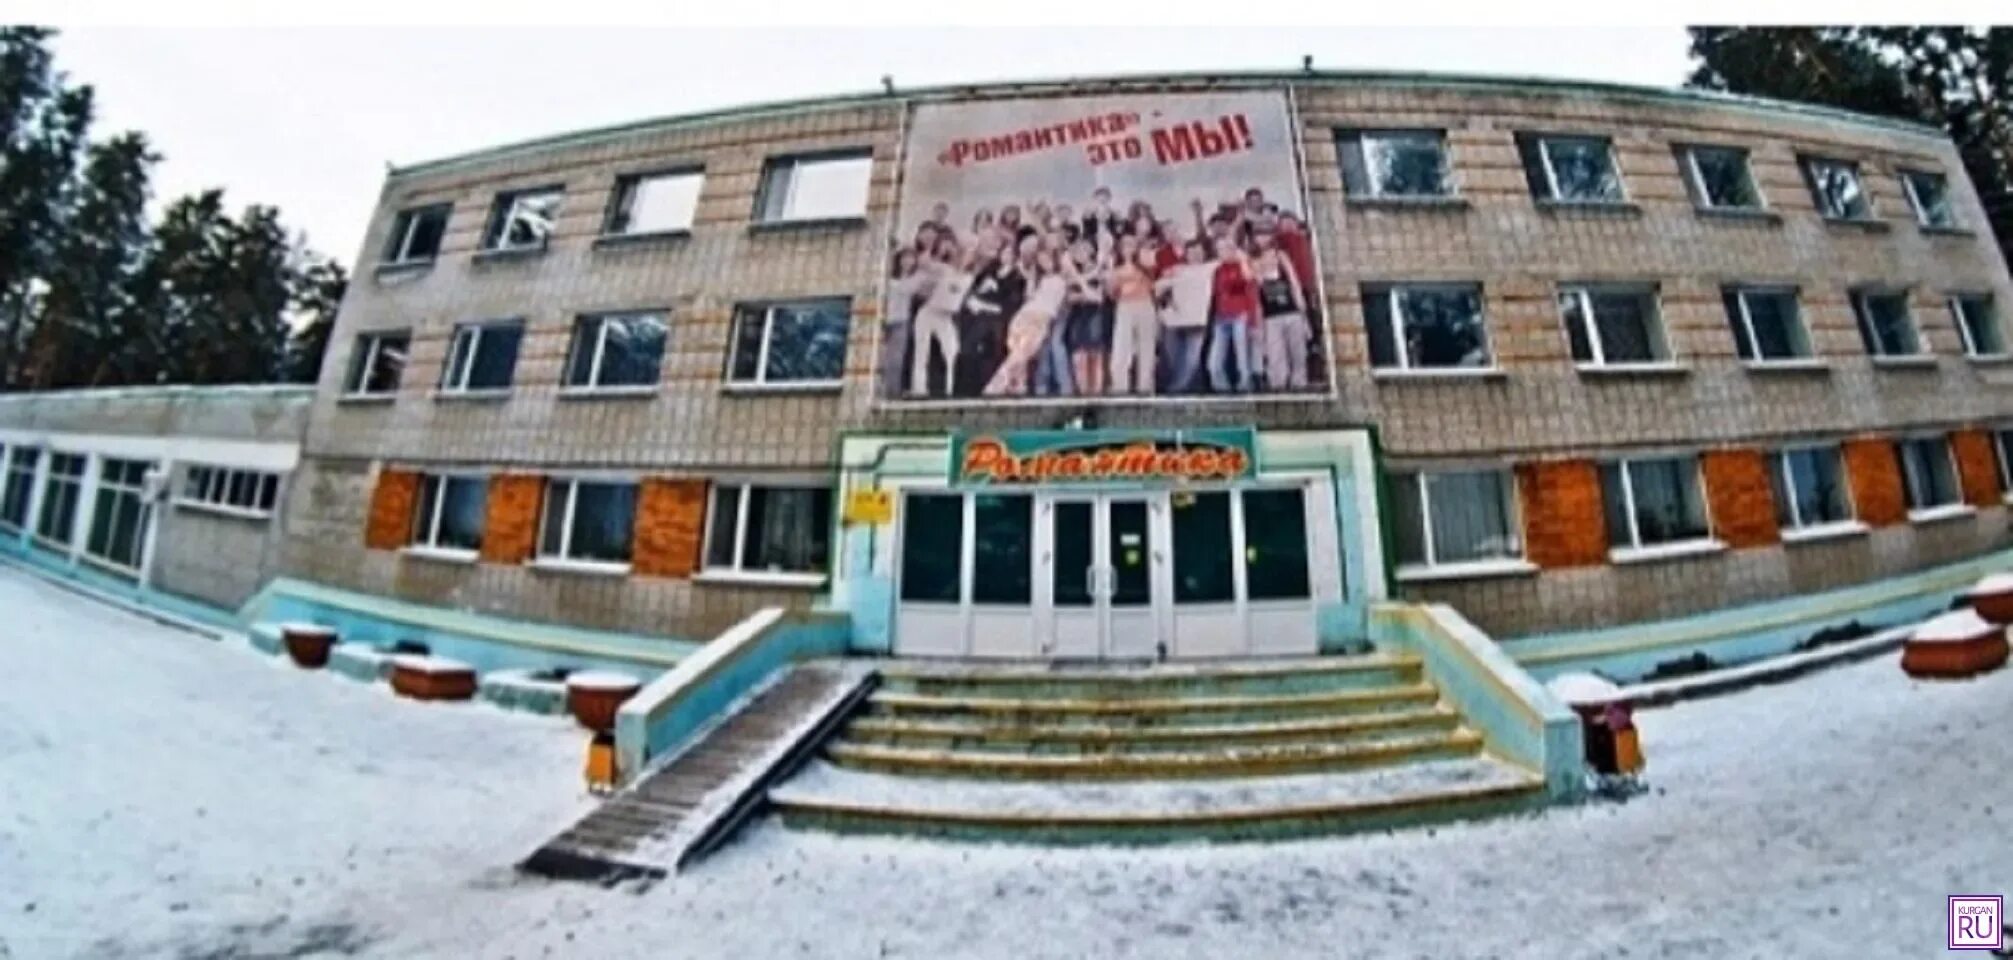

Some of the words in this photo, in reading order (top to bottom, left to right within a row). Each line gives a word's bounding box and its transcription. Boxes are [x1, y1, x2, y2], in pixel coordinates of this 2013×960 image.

[936, 112, 1141, 168] «Романтика»
[1151, 112, 1254, 166] МЫ!
[963, 438, 1247, 480] Романтика
